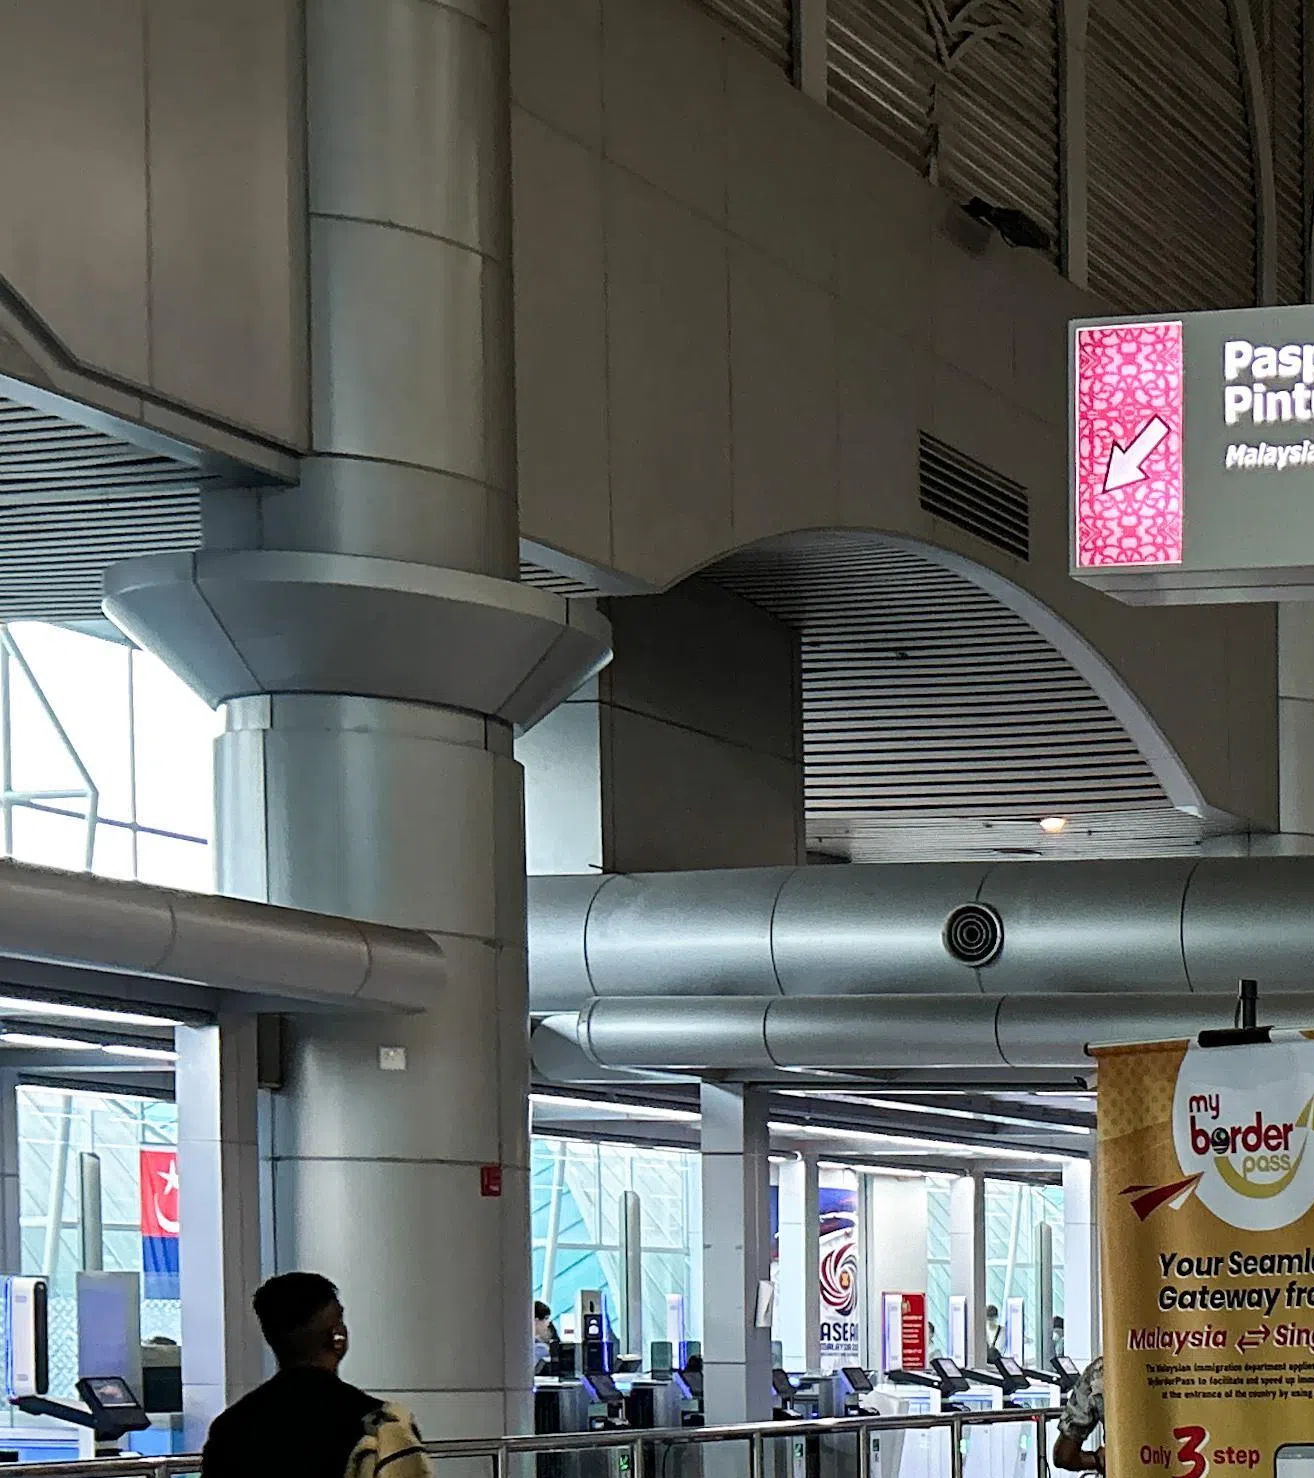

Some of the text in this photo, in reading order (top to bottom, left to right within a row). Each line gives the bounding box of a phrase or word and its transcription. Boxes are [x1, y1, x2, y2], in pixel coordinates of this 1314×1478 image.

[1189, 1093, 1219, 1120] my
[1242, 1154, 1291, 1181] pass
[1159, 1253, 1224, 1279] Your
[1159, 1282, 1281, 1318] Gateway
[1127, 1324, 1228, 1356] Malaysia
[1140, 1445, 1171, 1469] Only
[1213, 1449, 1260, 1469] step
